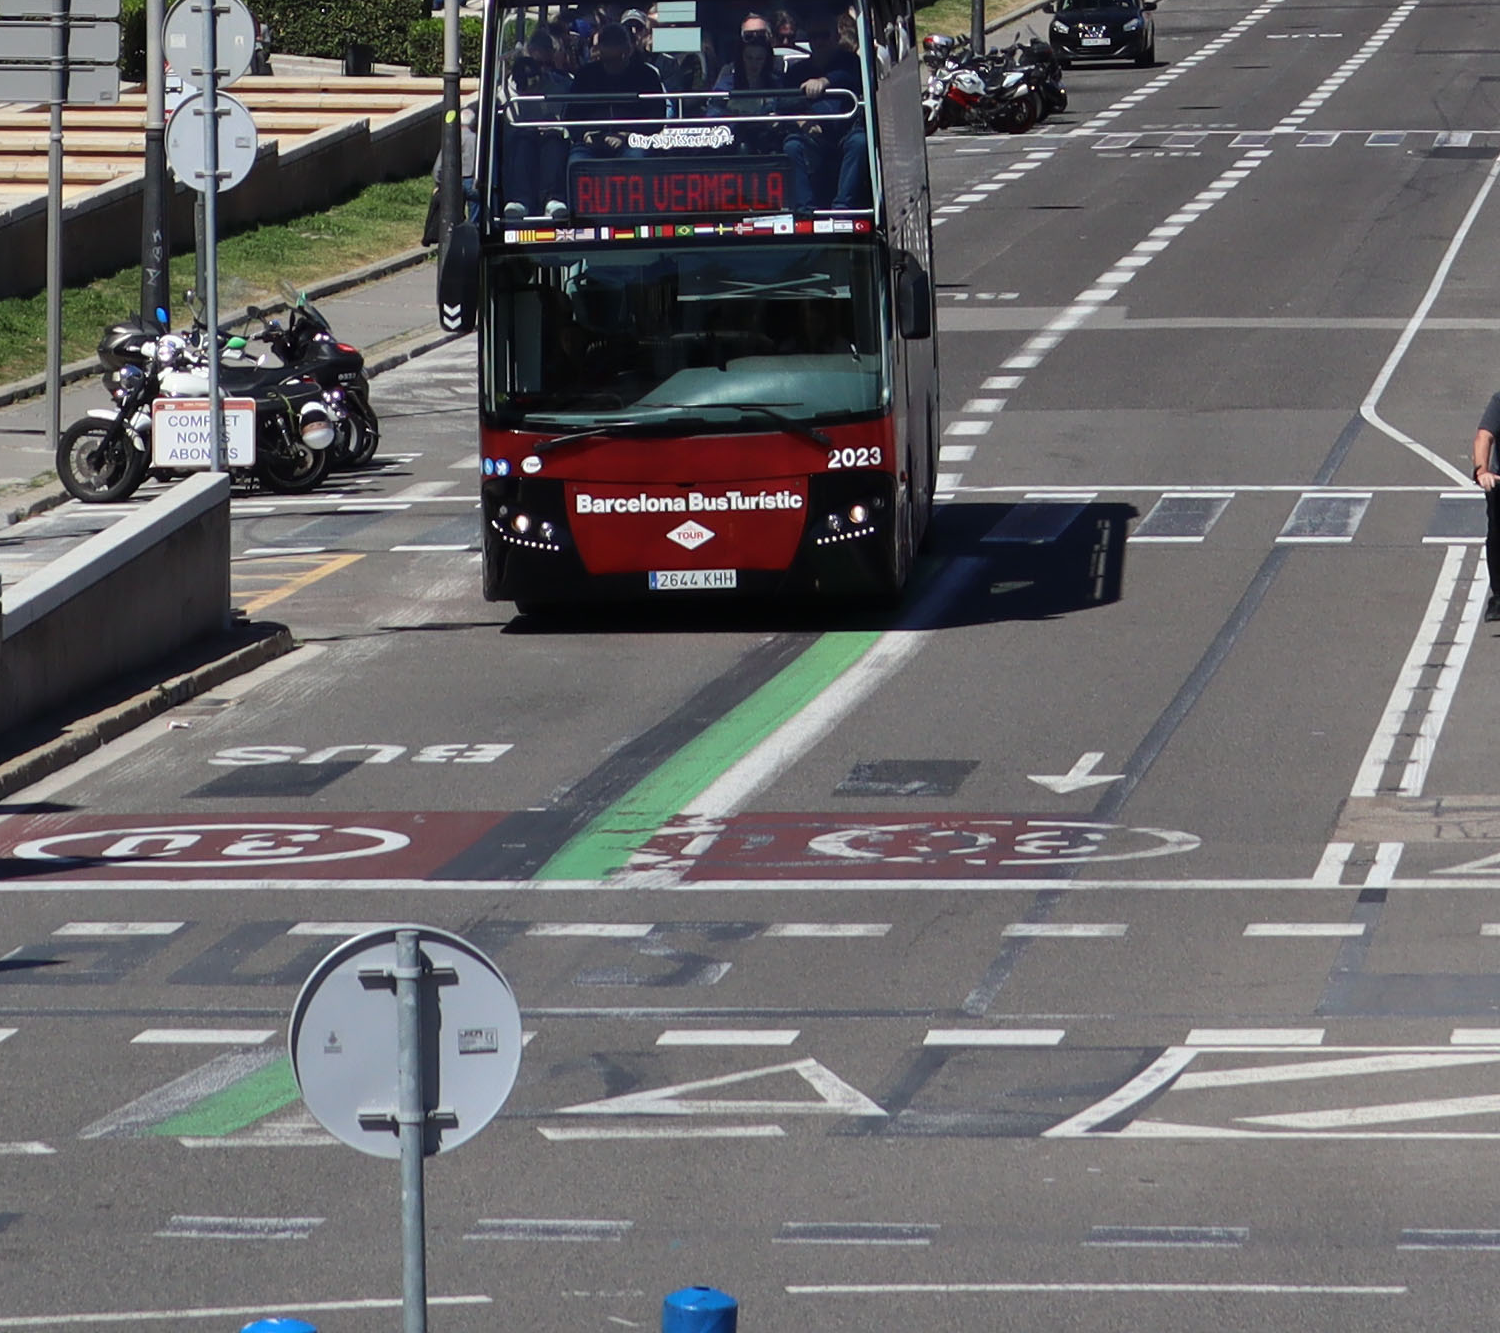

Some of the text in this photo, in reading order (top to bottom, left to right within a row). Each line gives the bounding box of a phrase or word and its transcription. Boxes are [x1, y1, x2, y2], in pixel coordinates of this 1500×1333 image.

[577, 172, 784, 214] RUTA VERMELLA
[177, 432, 230, 444] NOMS
[169, 448, 238, 460] ABONTS
[827, 446, 882, 468] 2023
[576, 490, 803, 513] Barcelona BusTurístic
[676, 531, 704, 541] TOUR
[659, 571, 734, 587] 2644 KHH
